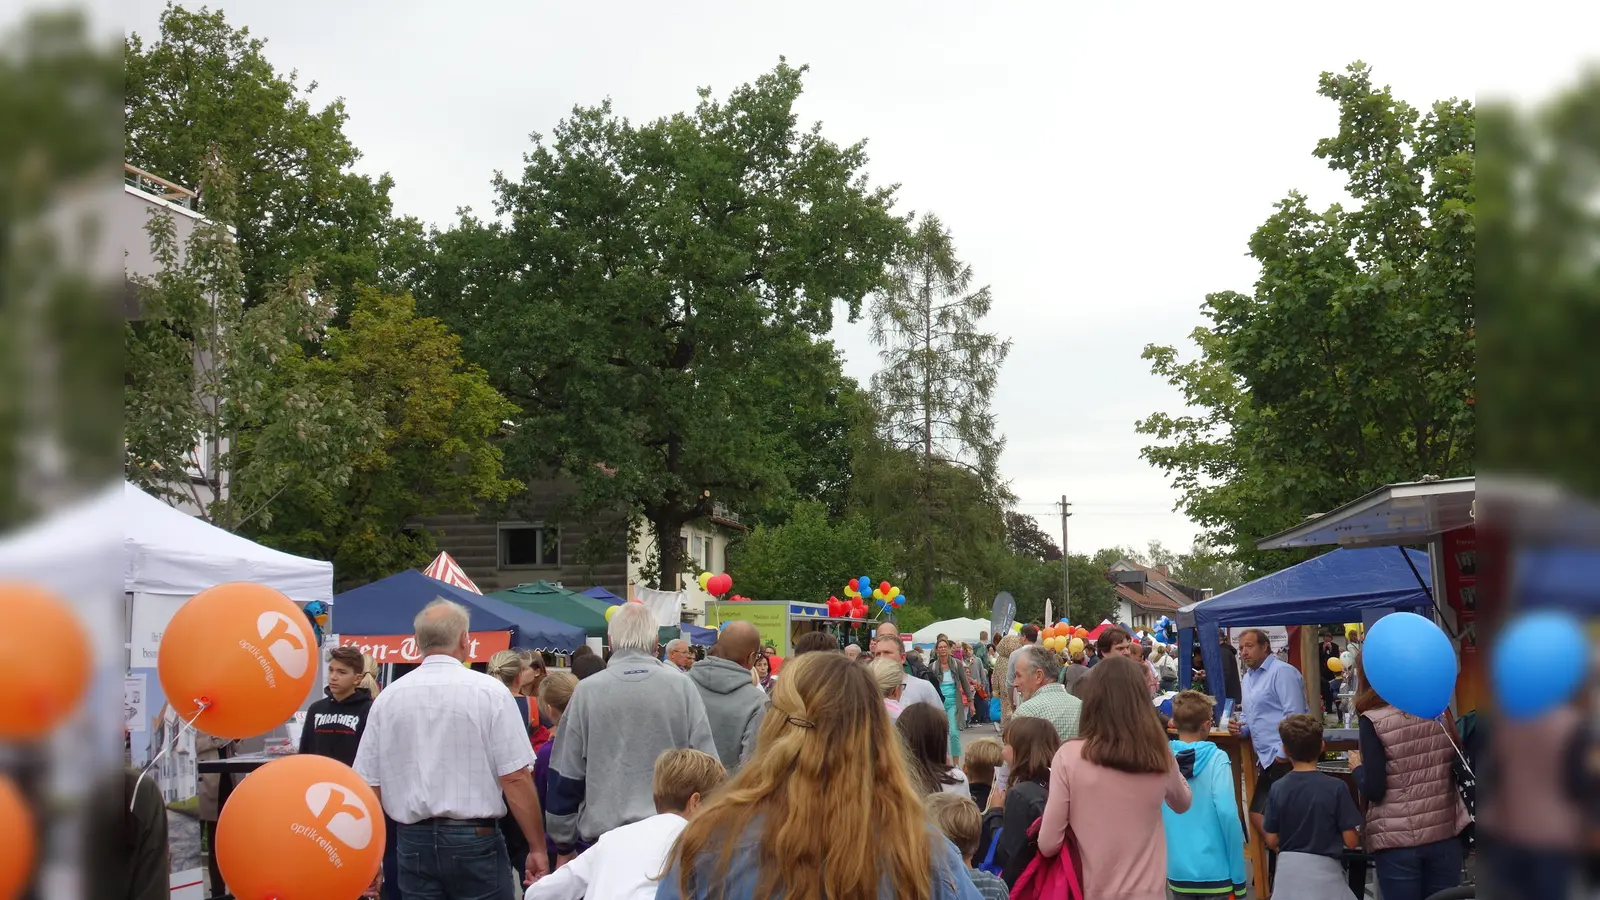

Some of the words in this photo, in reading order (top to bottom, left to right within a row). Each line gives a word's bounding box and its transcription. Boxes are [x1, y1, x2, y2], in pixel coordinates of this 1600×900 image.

[238, 639, 260, 658] optik
[257, 655, 276, 689] reiniger
[290, 822, 318, 842] optik
[315, 835, 344, 870] reiniger
